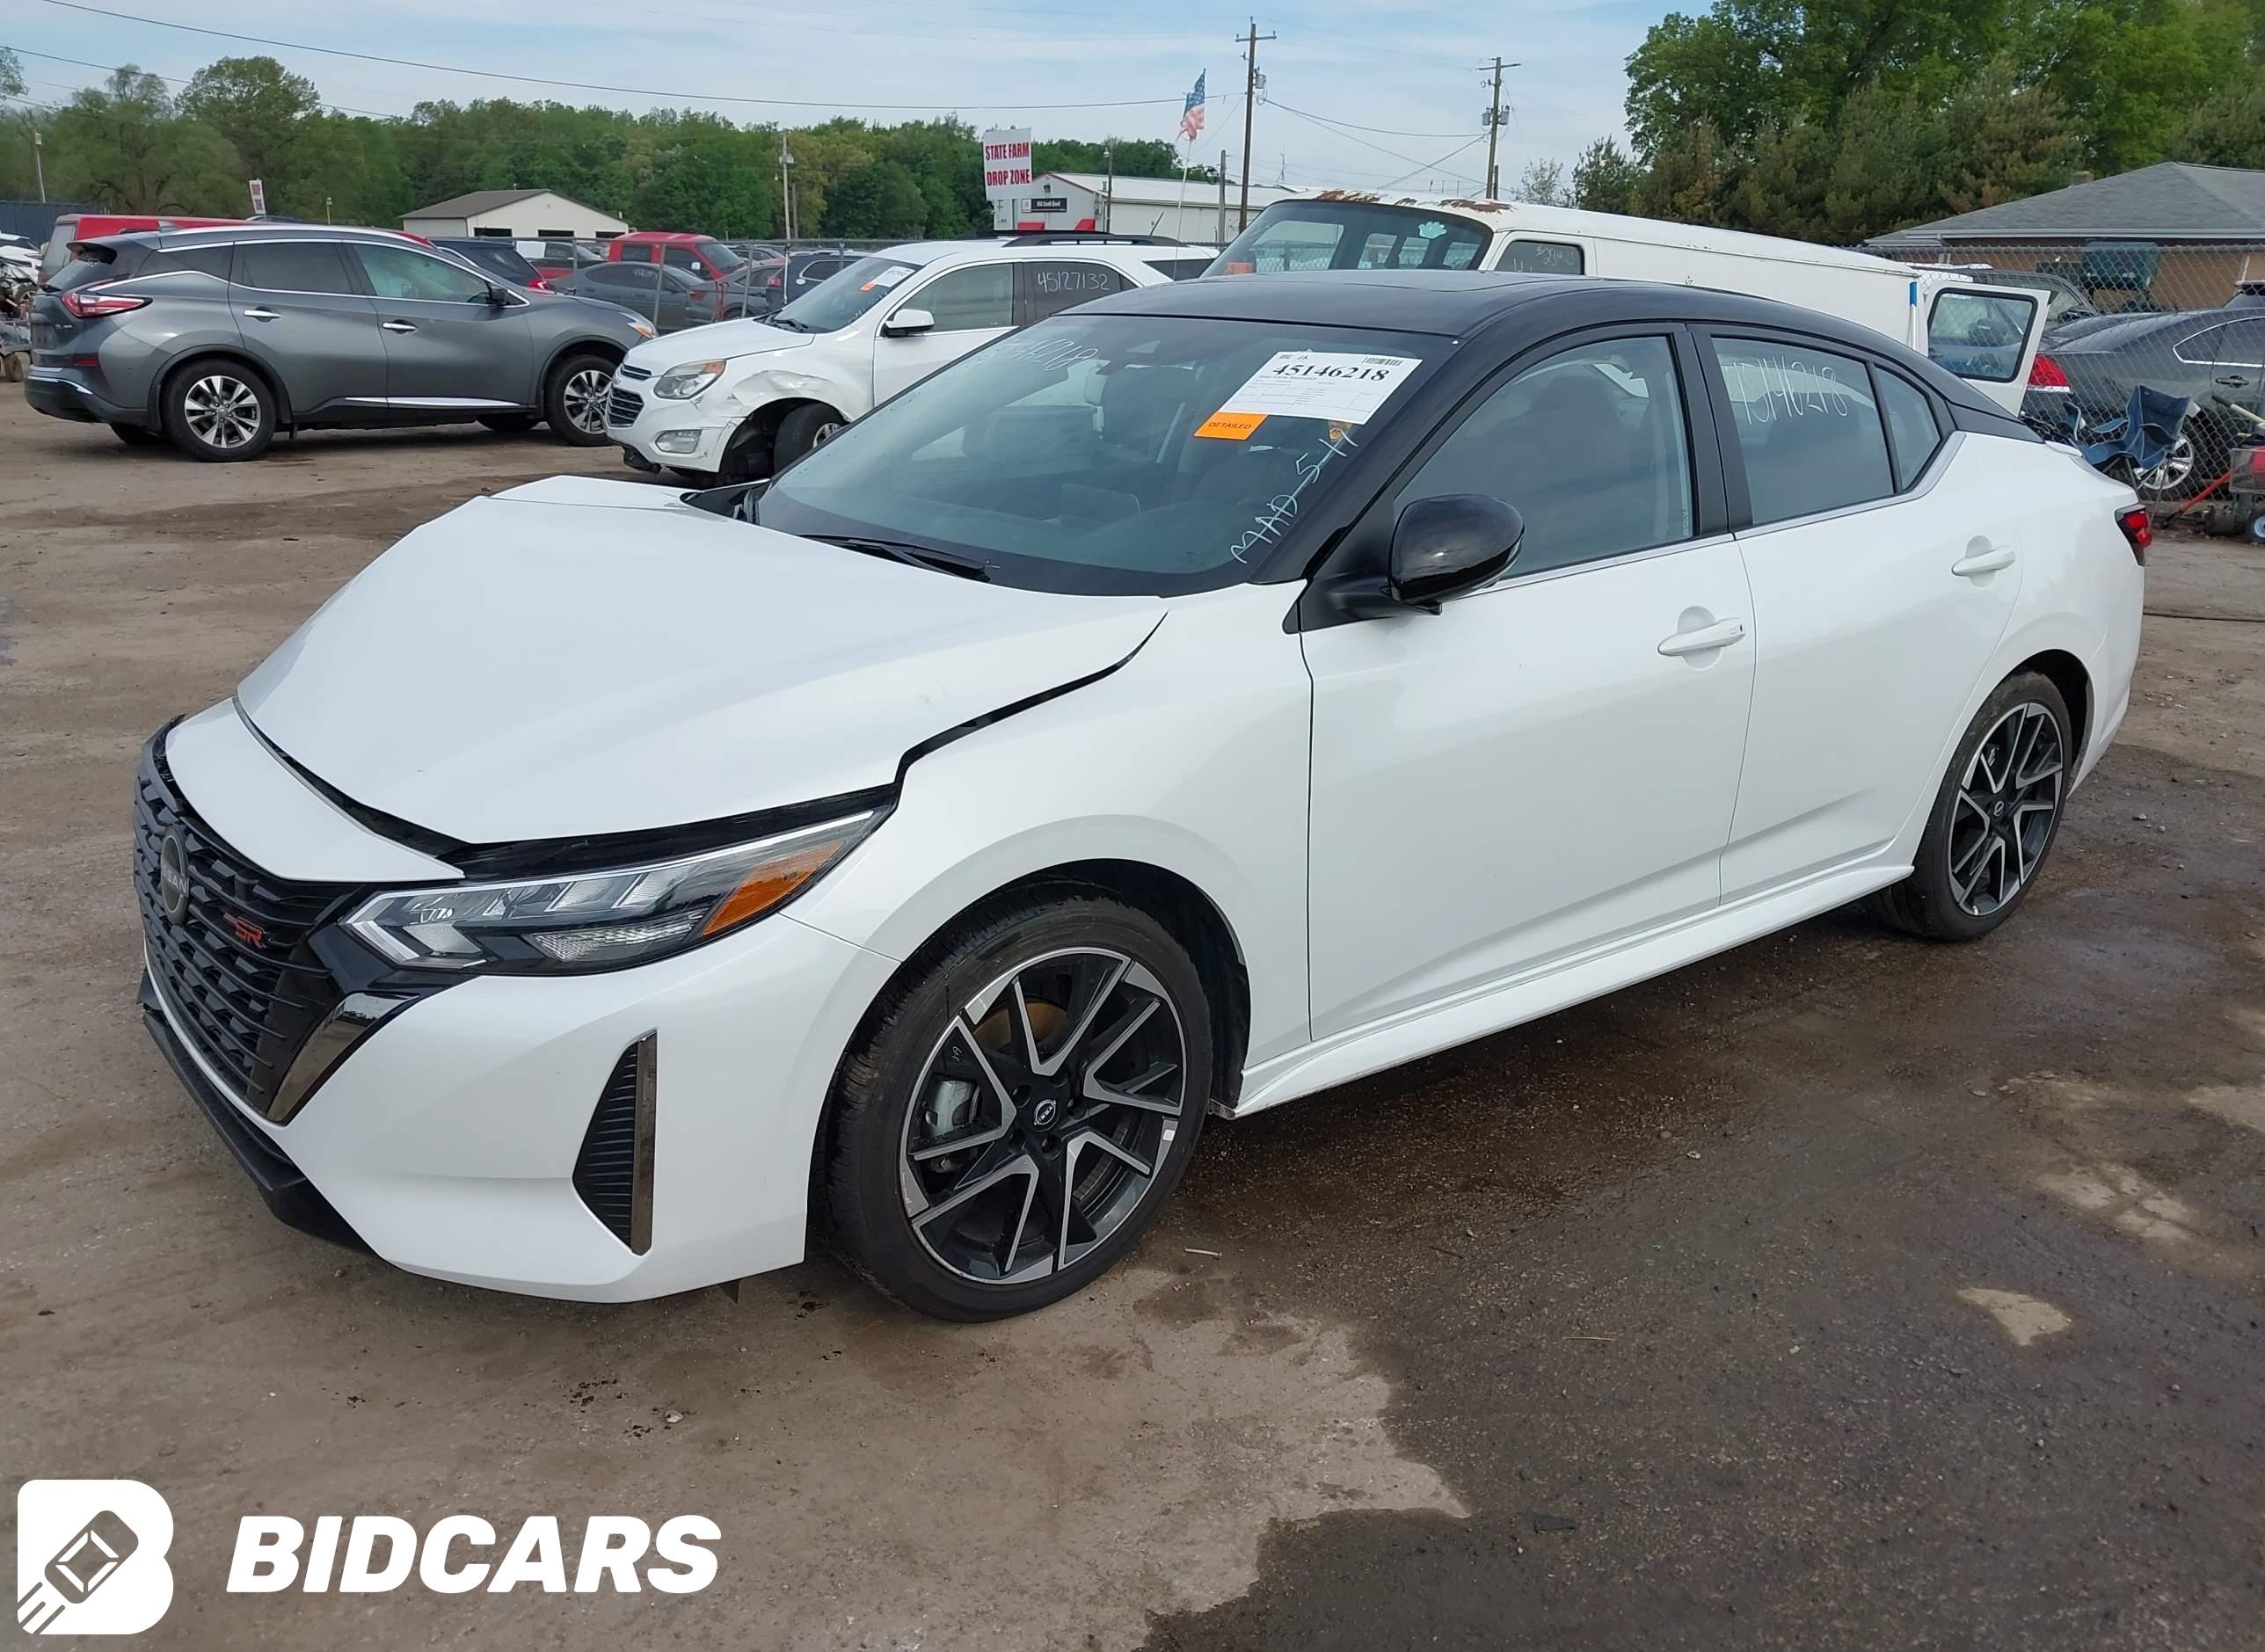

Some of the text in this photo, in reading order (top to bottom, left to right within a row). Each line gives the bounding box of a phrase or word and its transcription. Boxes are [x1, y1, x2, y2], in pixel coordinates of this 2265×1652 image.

[985, 142, 1030, 160] STATE FARM
[987, 169, 1030, 186] DROP ZONE
[1038, 271, 1110, 293] 45127132
[1273, 364, 1389, 382] 45146218
[1208, 421, 1252, 430] DETAILED
